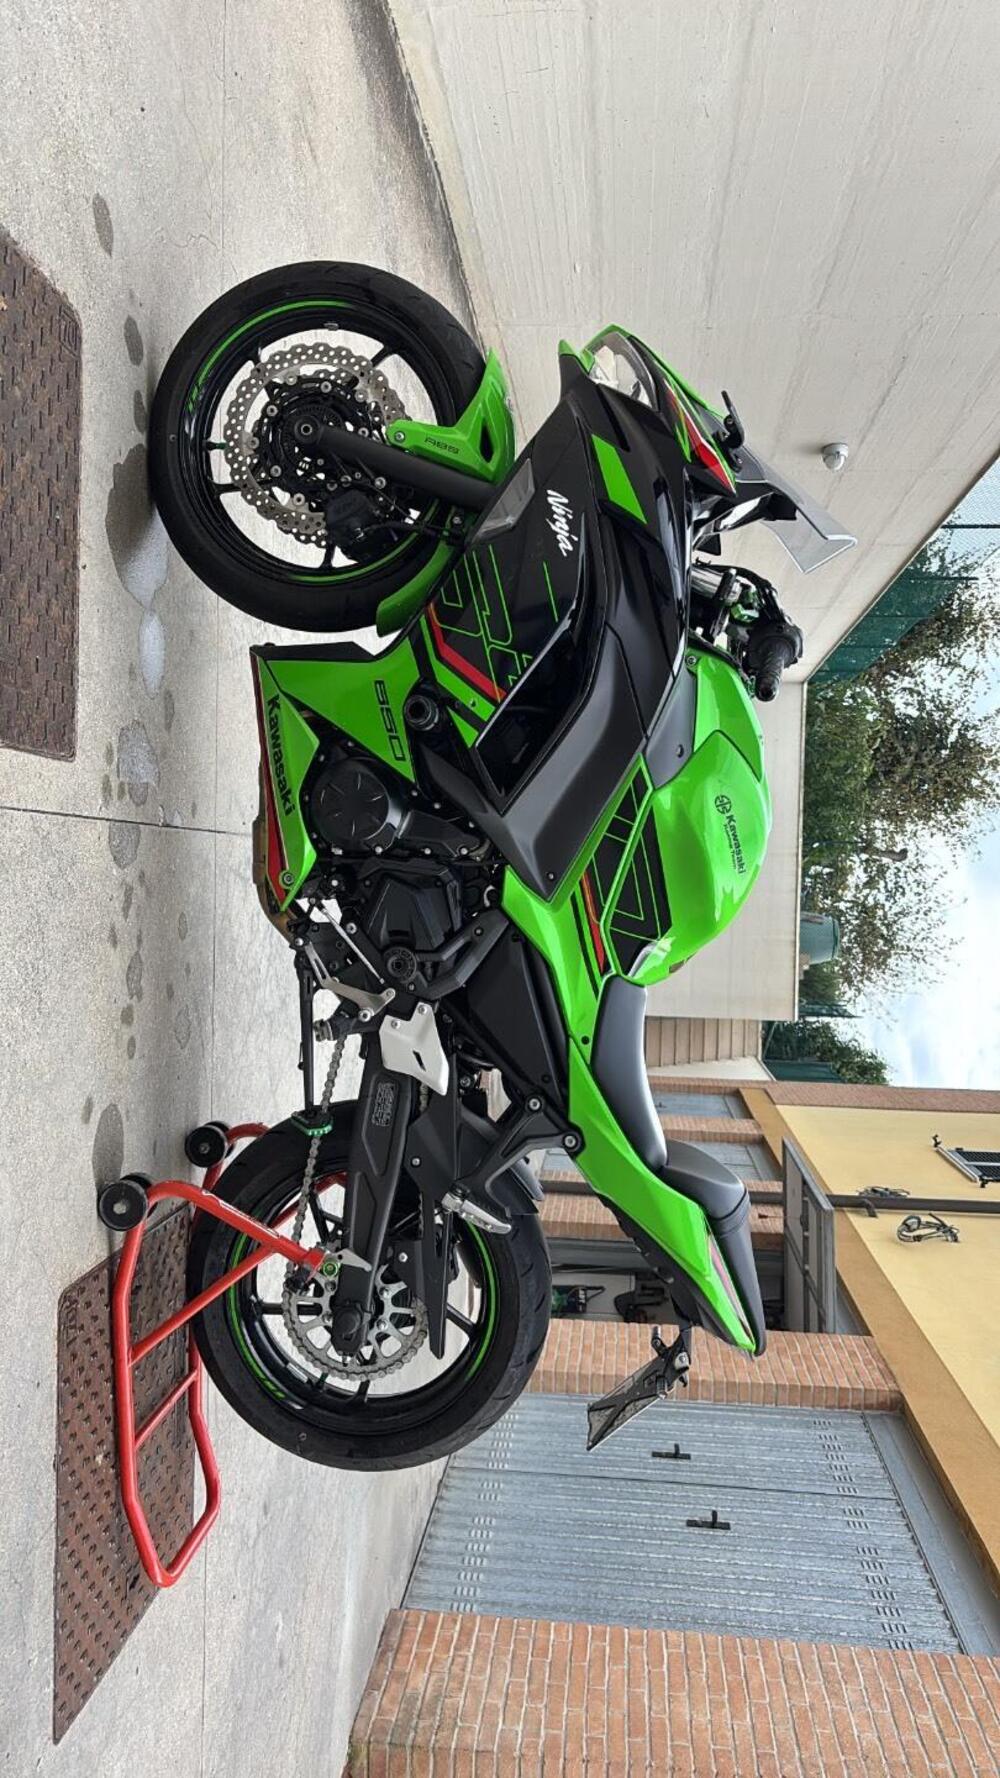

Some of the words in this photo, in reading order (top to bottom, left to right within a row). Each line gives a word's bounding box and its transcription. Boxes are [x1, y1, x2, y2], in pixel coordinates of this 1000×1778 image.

[545, 489, 579, 557] Ninja
[266, 694, 295, 816] Kawasaki
[374, 680, 405, 762] 650
[726, 814, 746, 874] Kawasaki
